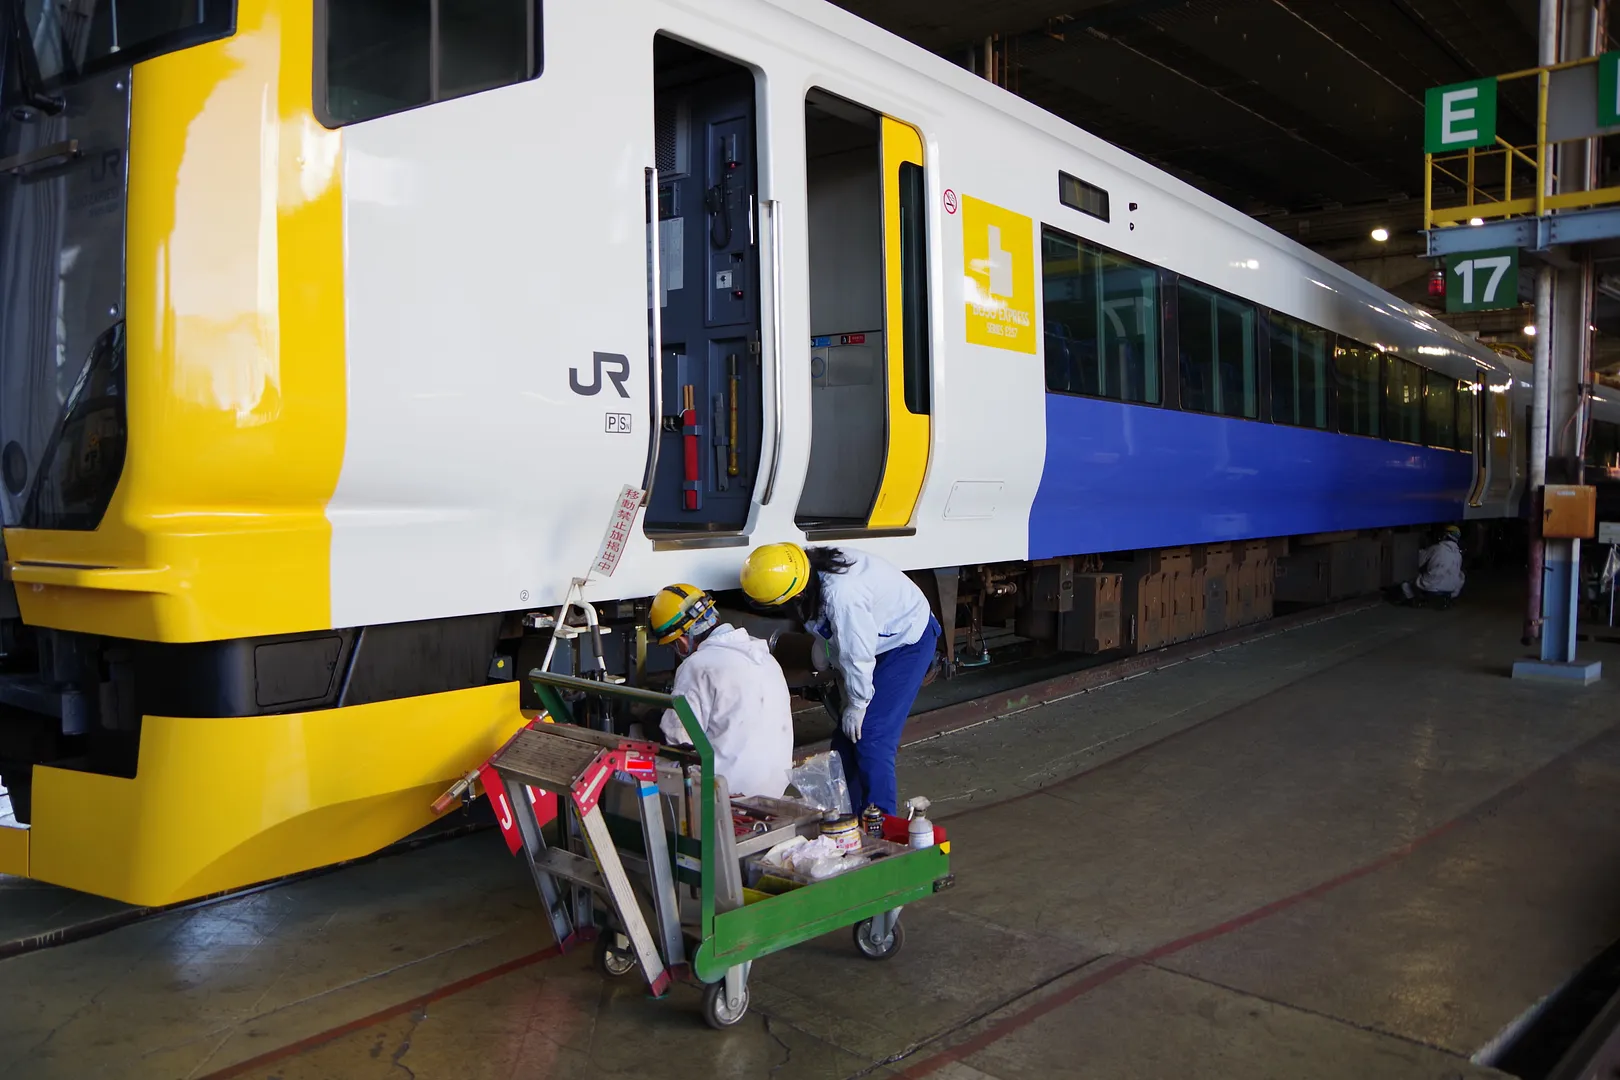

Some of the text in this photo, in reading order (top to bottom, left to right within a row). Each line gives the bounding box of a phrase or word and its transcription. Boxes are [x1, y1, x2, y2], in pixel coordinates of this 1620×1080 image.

[1441, 87, 1478, 144] E
[1453, 256, 1511, 304] 17
[998, 307, 1030, 327] EXPRESS
[569, 351, 630, 398] JR
[597, 488, 640, 572] 移動禁止旗掲出中
